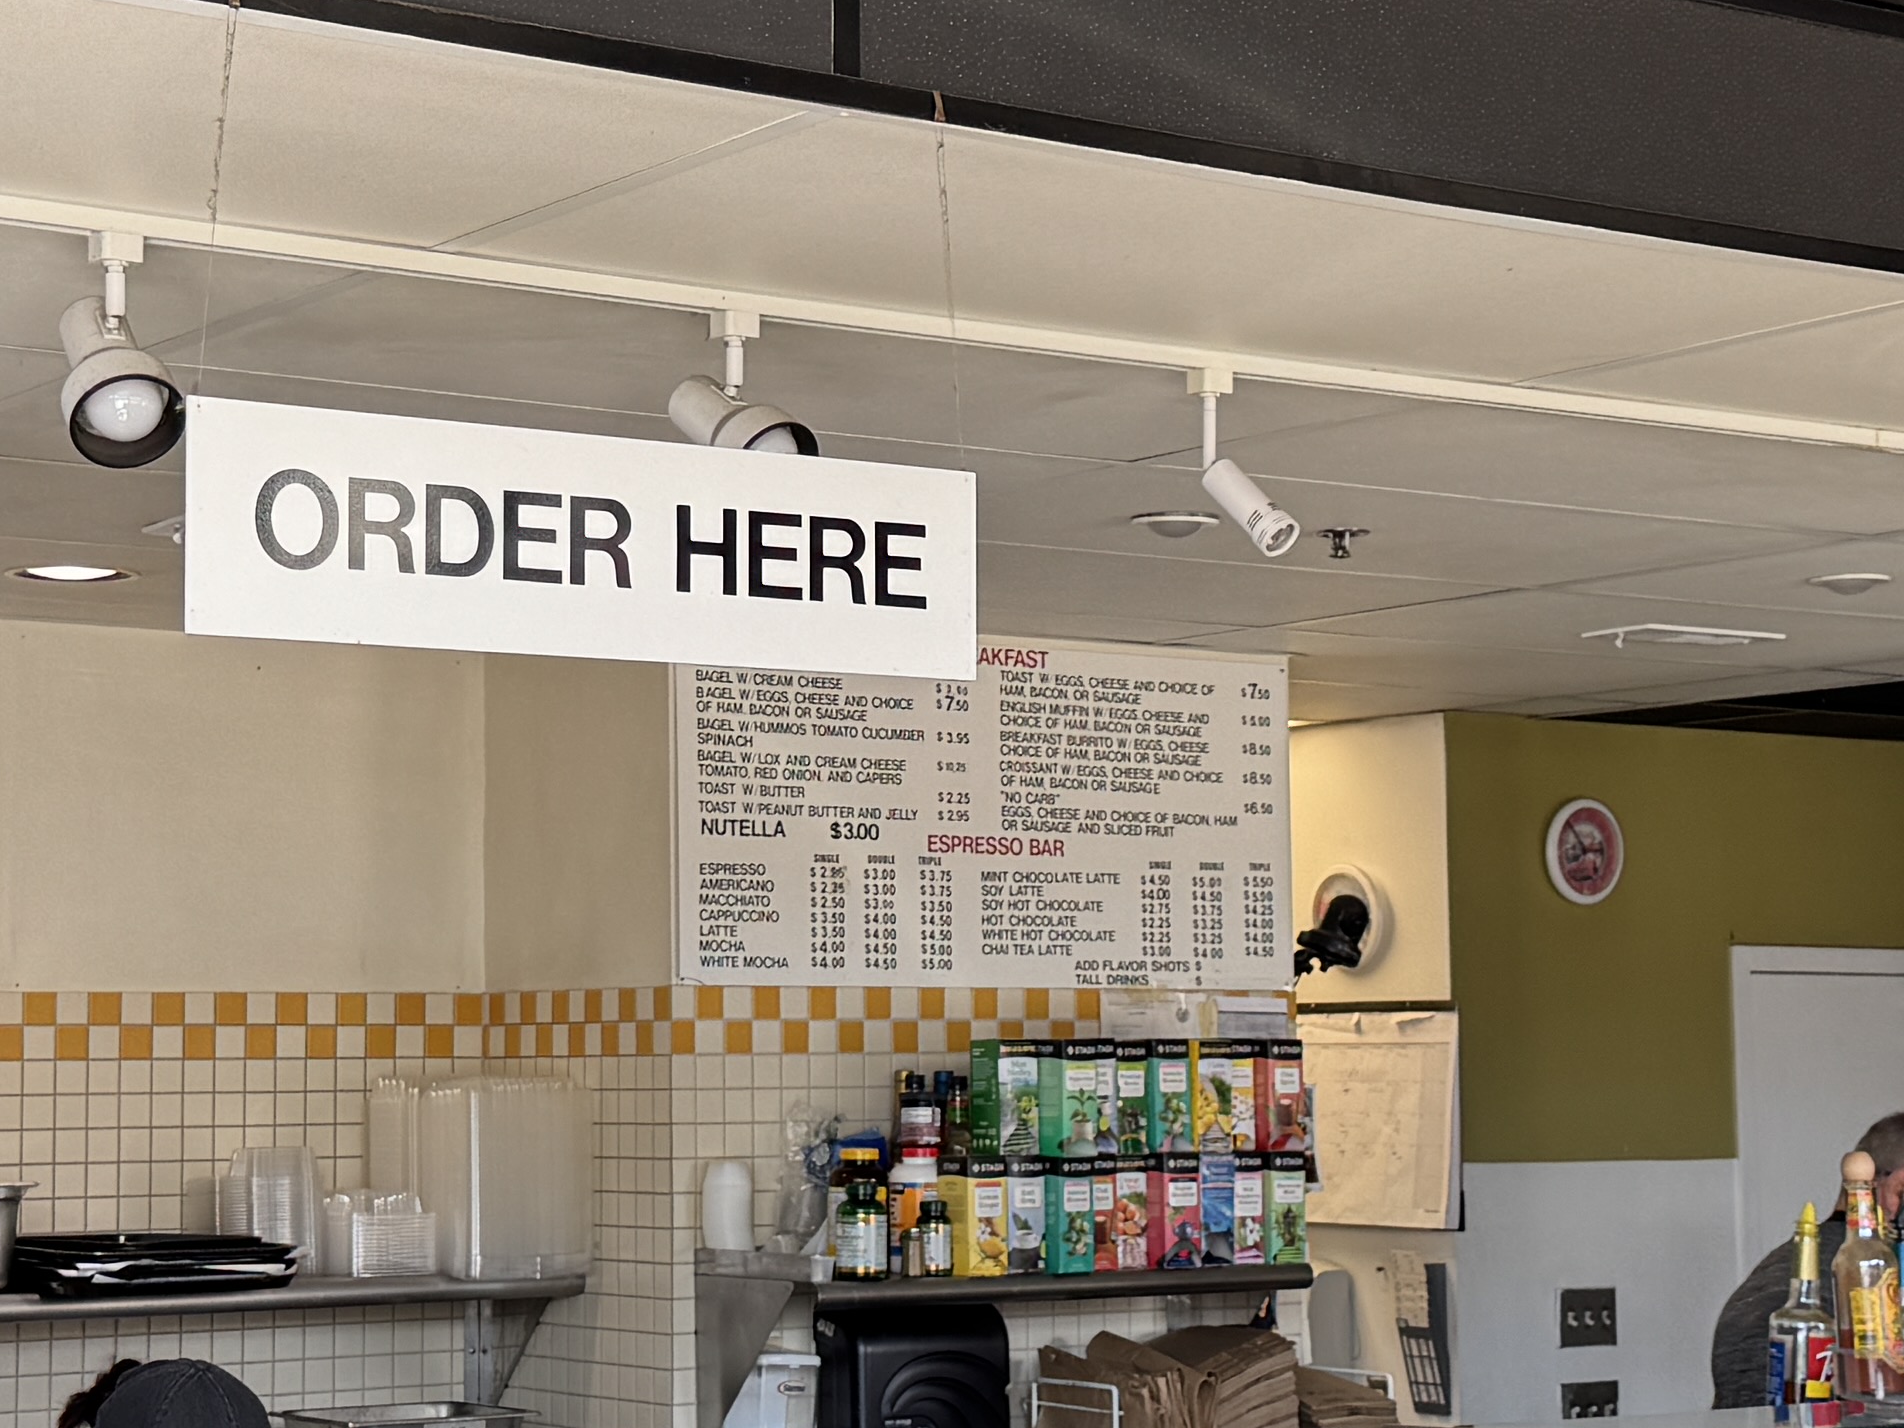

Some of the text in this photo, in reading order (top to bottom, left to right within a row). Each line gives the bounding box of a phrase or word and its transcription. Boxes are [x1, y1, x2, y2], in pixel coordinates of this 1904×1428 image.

[255, 468, 927, 611] ORDER HERE
[977, 647, 1048, 669] AKFAST
[701, 820, 880, 841] NUTELLA $3.00
[927, 835, 1065, 857] ESPRESSO BAR
[699, 863, 766, 875] ESPRESSO
[700, 879, 774, 892] AMERICANO
[699, 894, 770, 907] MACCHIATO
[699, 910, 779, 922] CAPPUCCINO
[699, 925, 737, 937] LATTE
[699, 941, 745, 952] MOCHA
[701, 956, 789, 968] WHITE MOCHA
